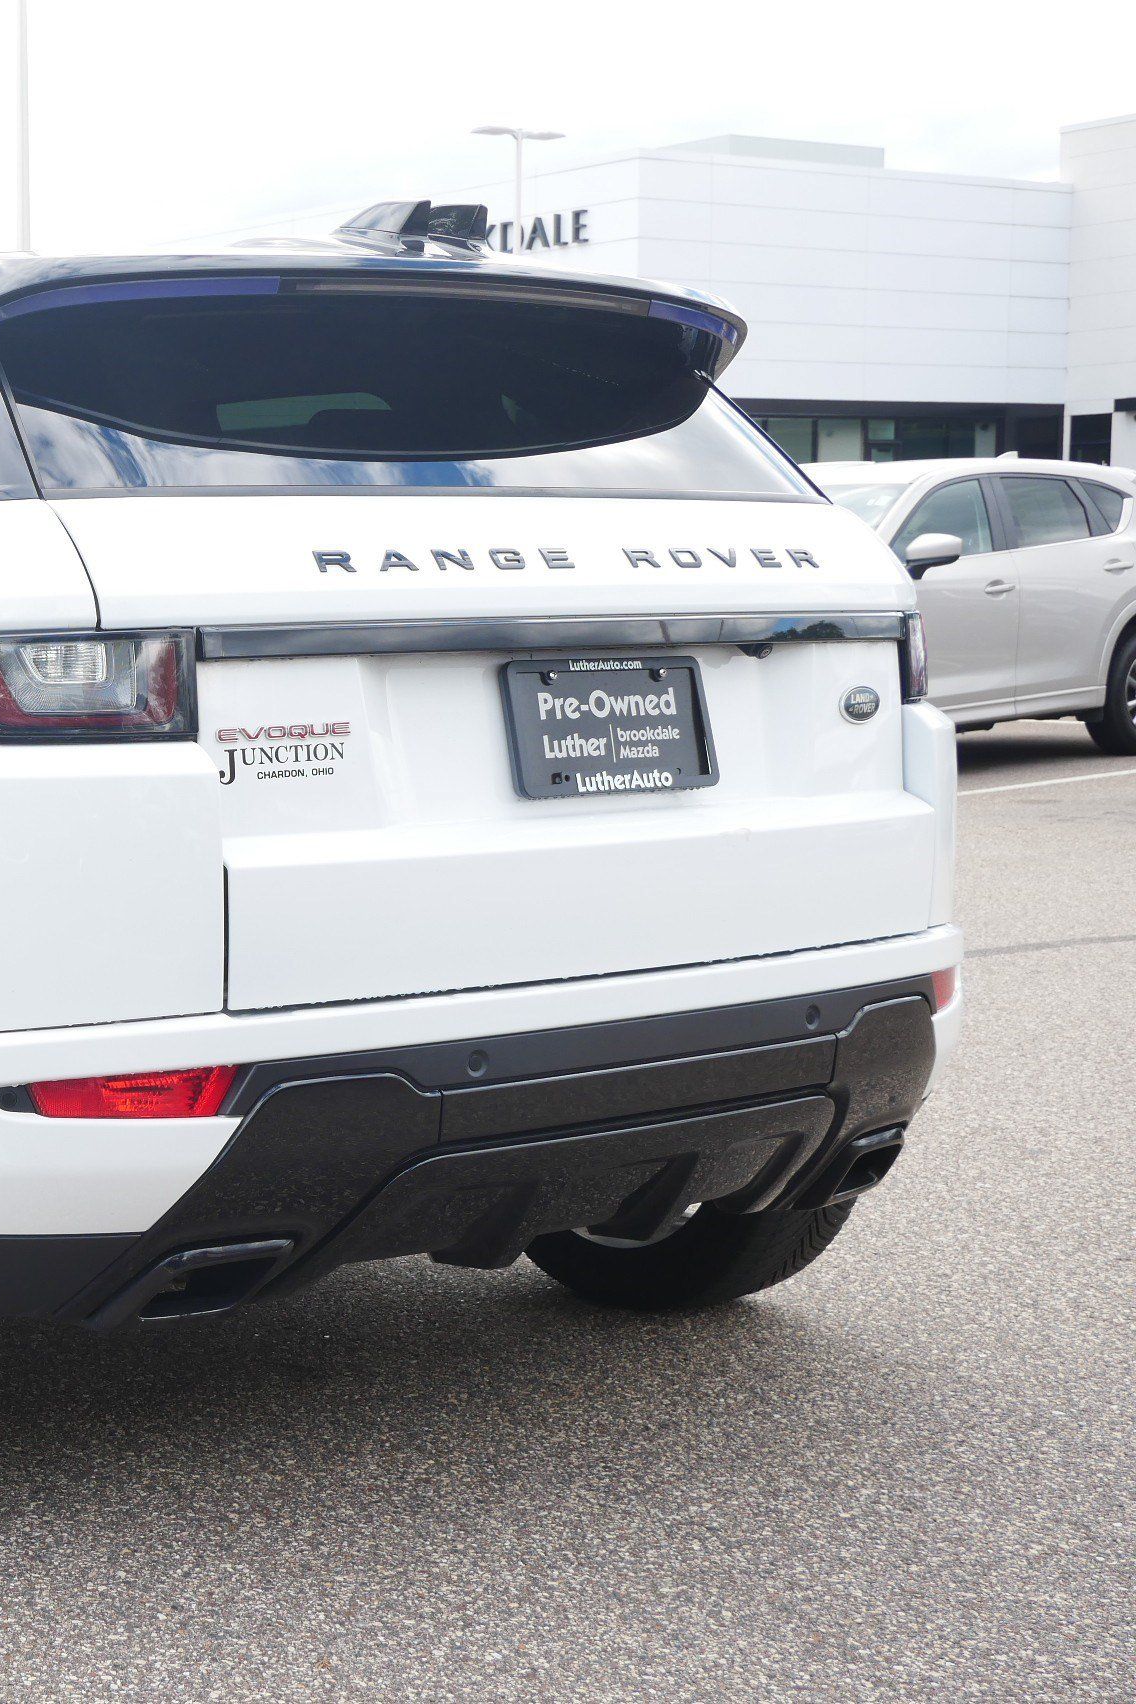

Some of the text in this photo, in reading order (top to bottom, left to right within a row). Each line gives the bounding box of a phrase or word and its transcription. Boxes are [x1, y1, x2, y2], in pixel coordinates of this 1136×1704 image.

[311, 546, 820, 573] RANGE ROVER
[568, 659, 642, 671] LutherAuto.com
[537, 687, 677, 720] Pre-Owned
[851, 693, 870, 703] LAND
[853, 703, 876, 714] ROVER
[216, 721, 351, 743] EVOQUE
[616, 725, 680, 742] brookdale
[542, 733, 607, 759] Luther
[619, 743, 660, 759] Mazda
[218, 741, 345, 785] JUNCTION
[256, 767, 334, 780] CHARDON, OHIO
[575, 768, 673, 793] LutherAuto
